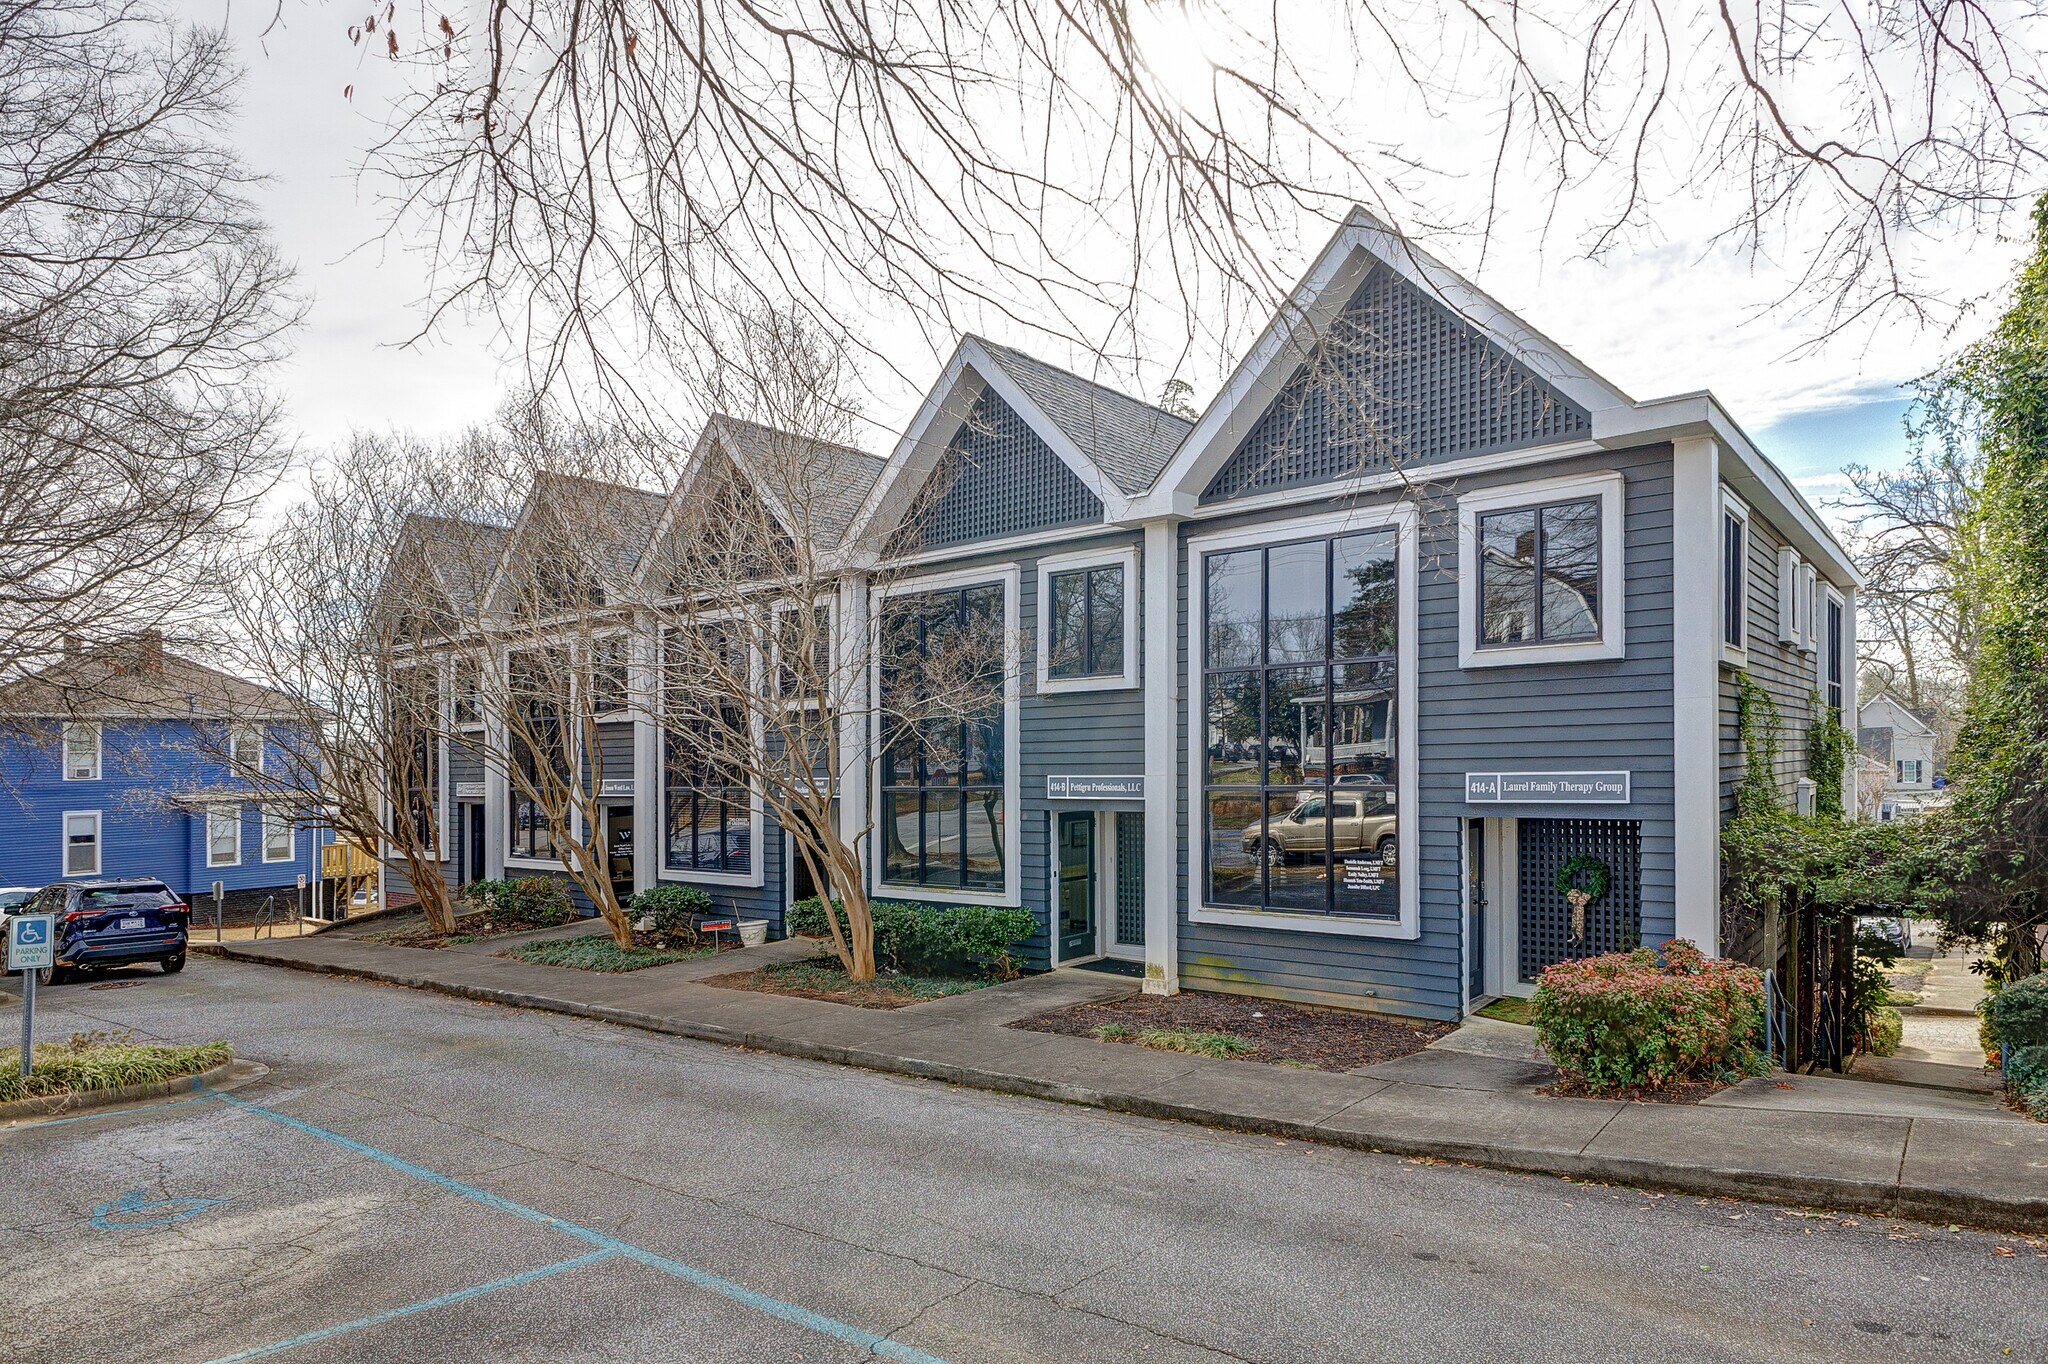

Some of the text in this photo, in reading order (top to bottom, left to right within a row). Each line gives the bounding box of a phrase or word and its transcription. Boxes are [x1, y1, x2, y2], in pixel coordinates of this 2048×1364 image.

[1050, 782, 1066, 792] 414-B
[1070, 782, 1141, 793] Pettigru Professionals, LLC
[1470, 782, 1496, 794] 414-A
[1503, 781, 1623, 794] Laurel Family Therapy Group
[619, 831, 631, 840] W
[15, 946, 48, 956] PARKING
[20, 955, 41, 963] ONLY
